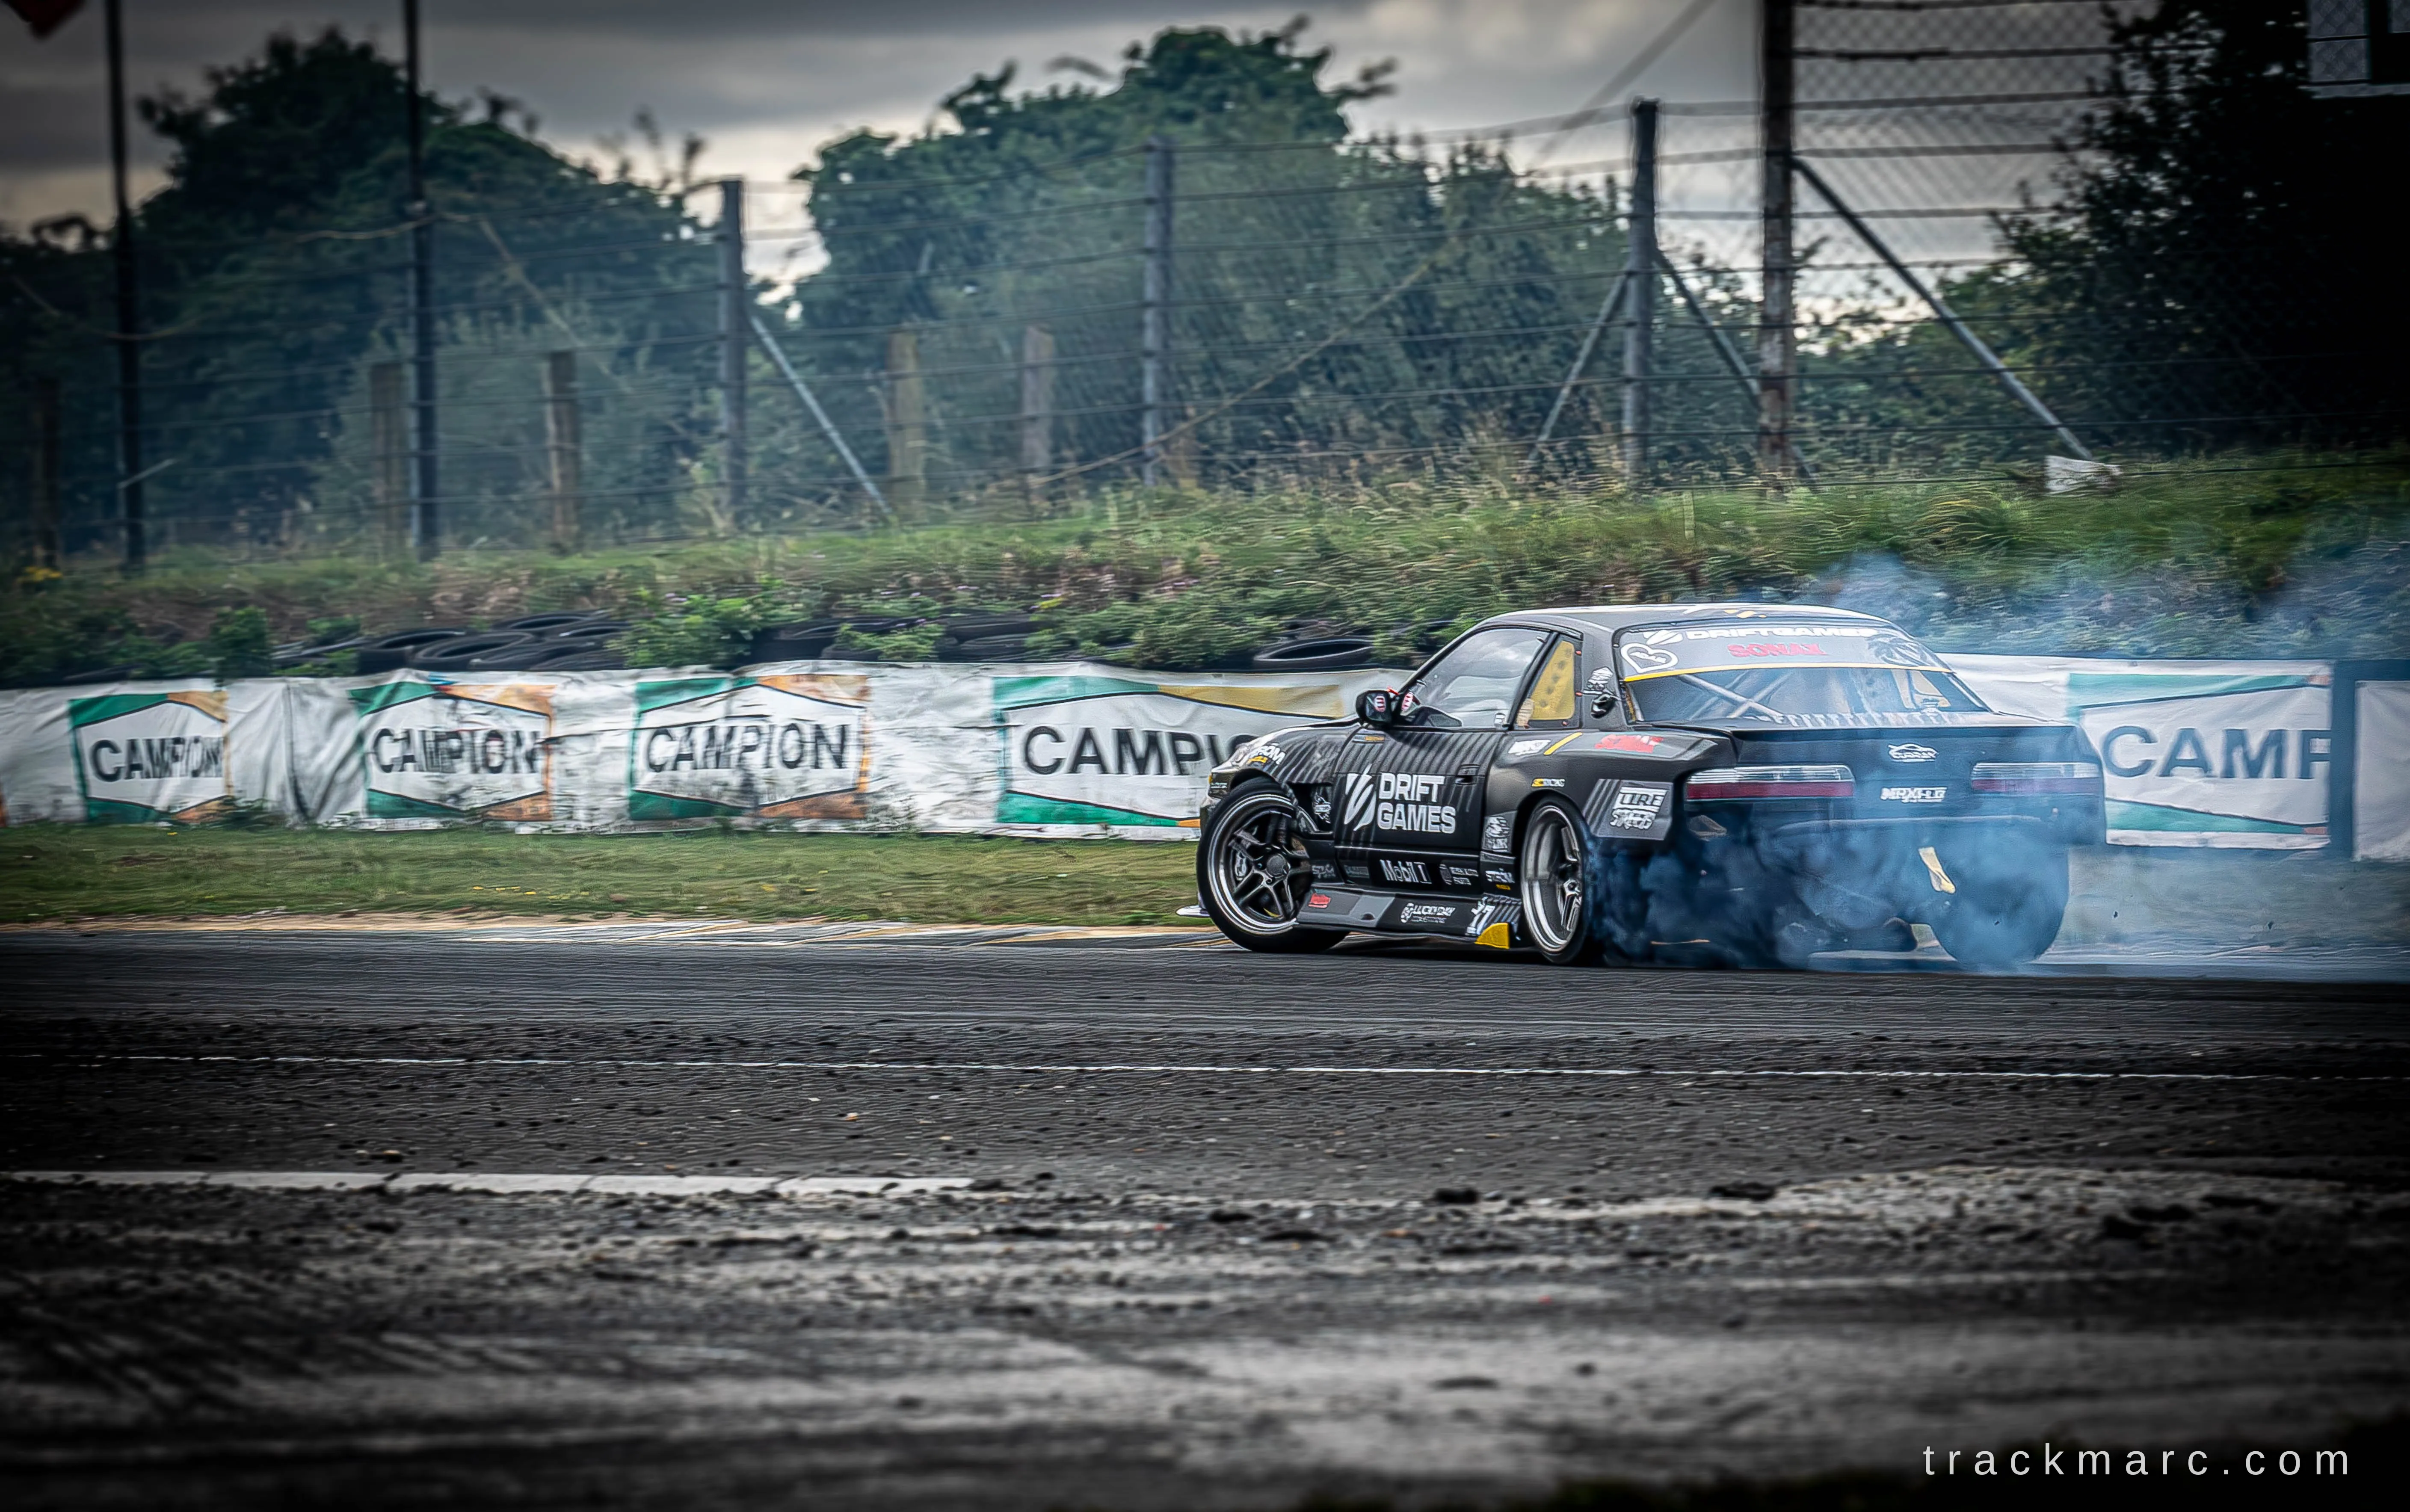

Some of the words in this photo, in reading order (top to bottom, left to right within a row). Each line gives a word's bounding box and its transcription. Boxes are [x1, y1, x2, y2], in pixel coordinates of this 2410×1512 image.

[1727, 643, 1827, 657] SONAX
[646, 722, 848, 771] CAMPION
[1025, 725, 1258, 776] CAMPI
[1379, 772, 1445, 802] DRIFT
[1377, 802, 1456, 834] GAMES
[1380, 859, 1419, 883] Mobil
